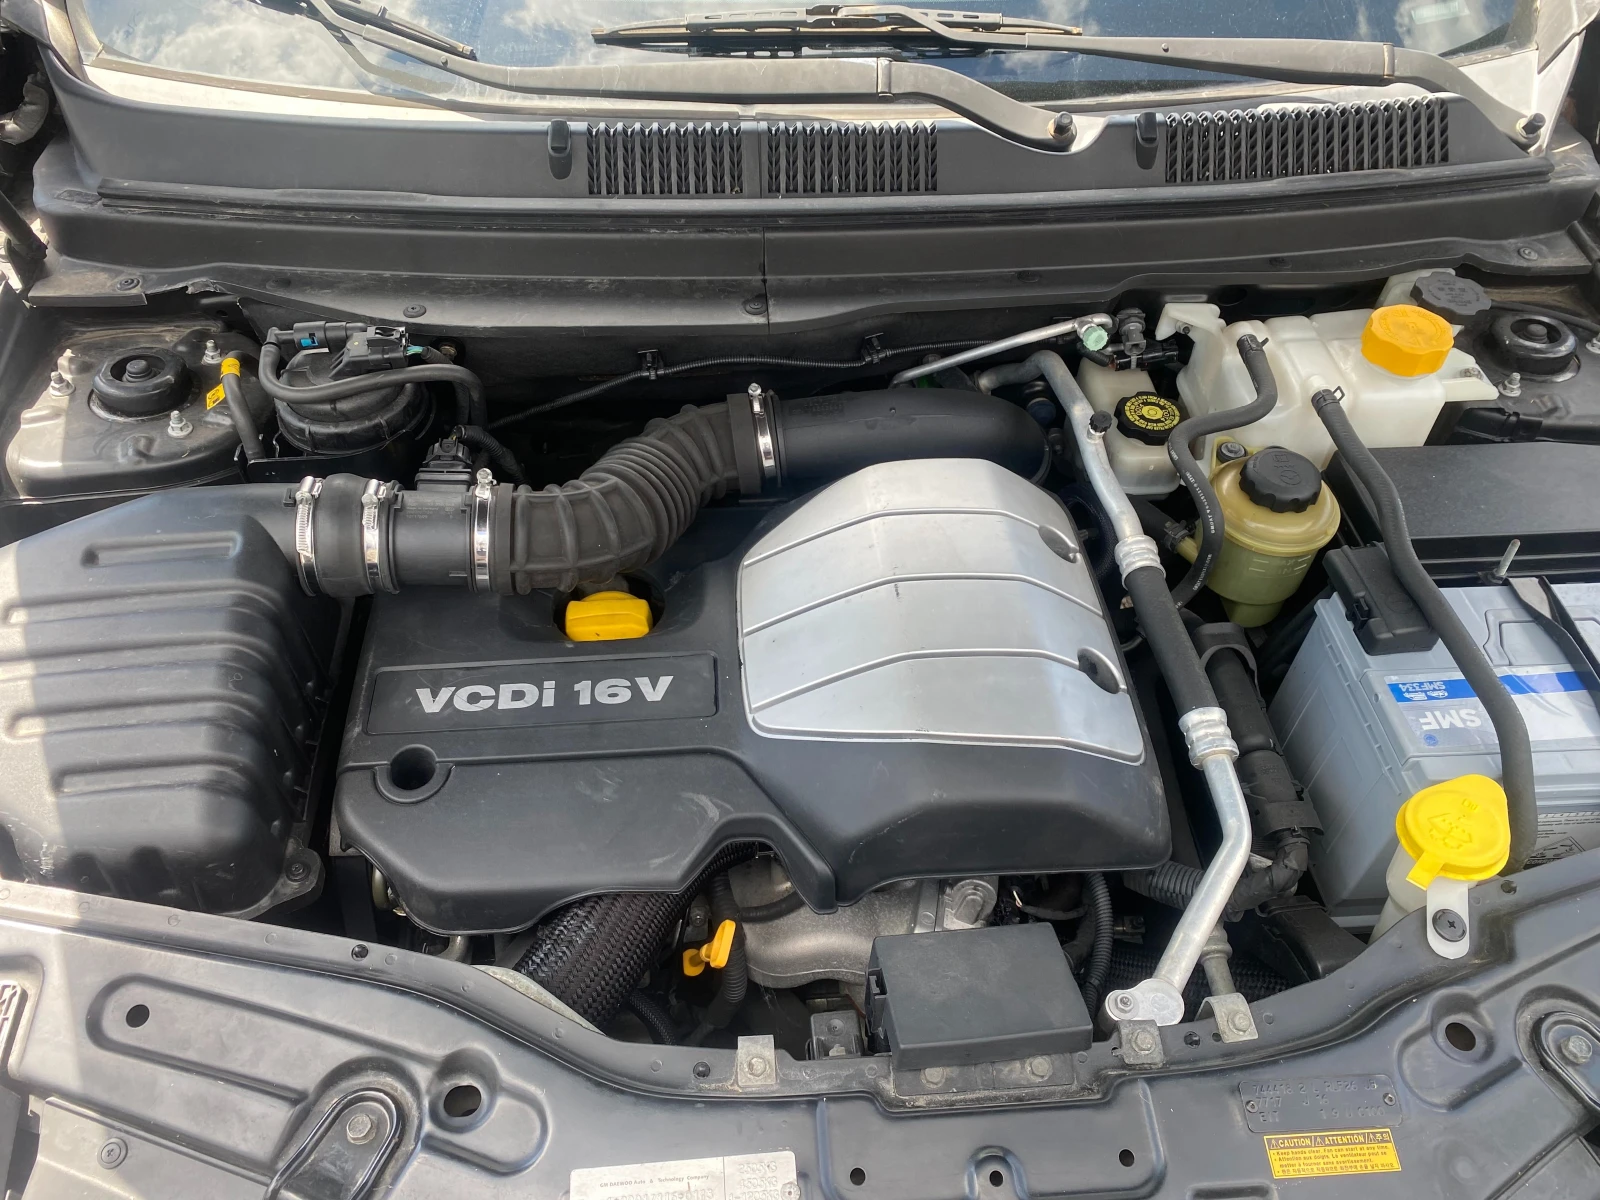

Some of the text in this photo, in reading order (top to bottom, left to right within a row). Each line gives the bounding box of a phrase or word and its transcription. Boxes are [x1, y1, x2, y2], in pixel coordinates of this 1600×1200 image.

[1399, 681, 1446, 691] SMF334
[416, 676, 674, 713] VCDi 16V
[1419, 708, 1482, 730] SMF
[1325, 1135, 1364, 1145] ATTENTION
[1376, 1133, 1390, 1141] 주의
[1278, 1137, 1311, 1148] CAUTION
